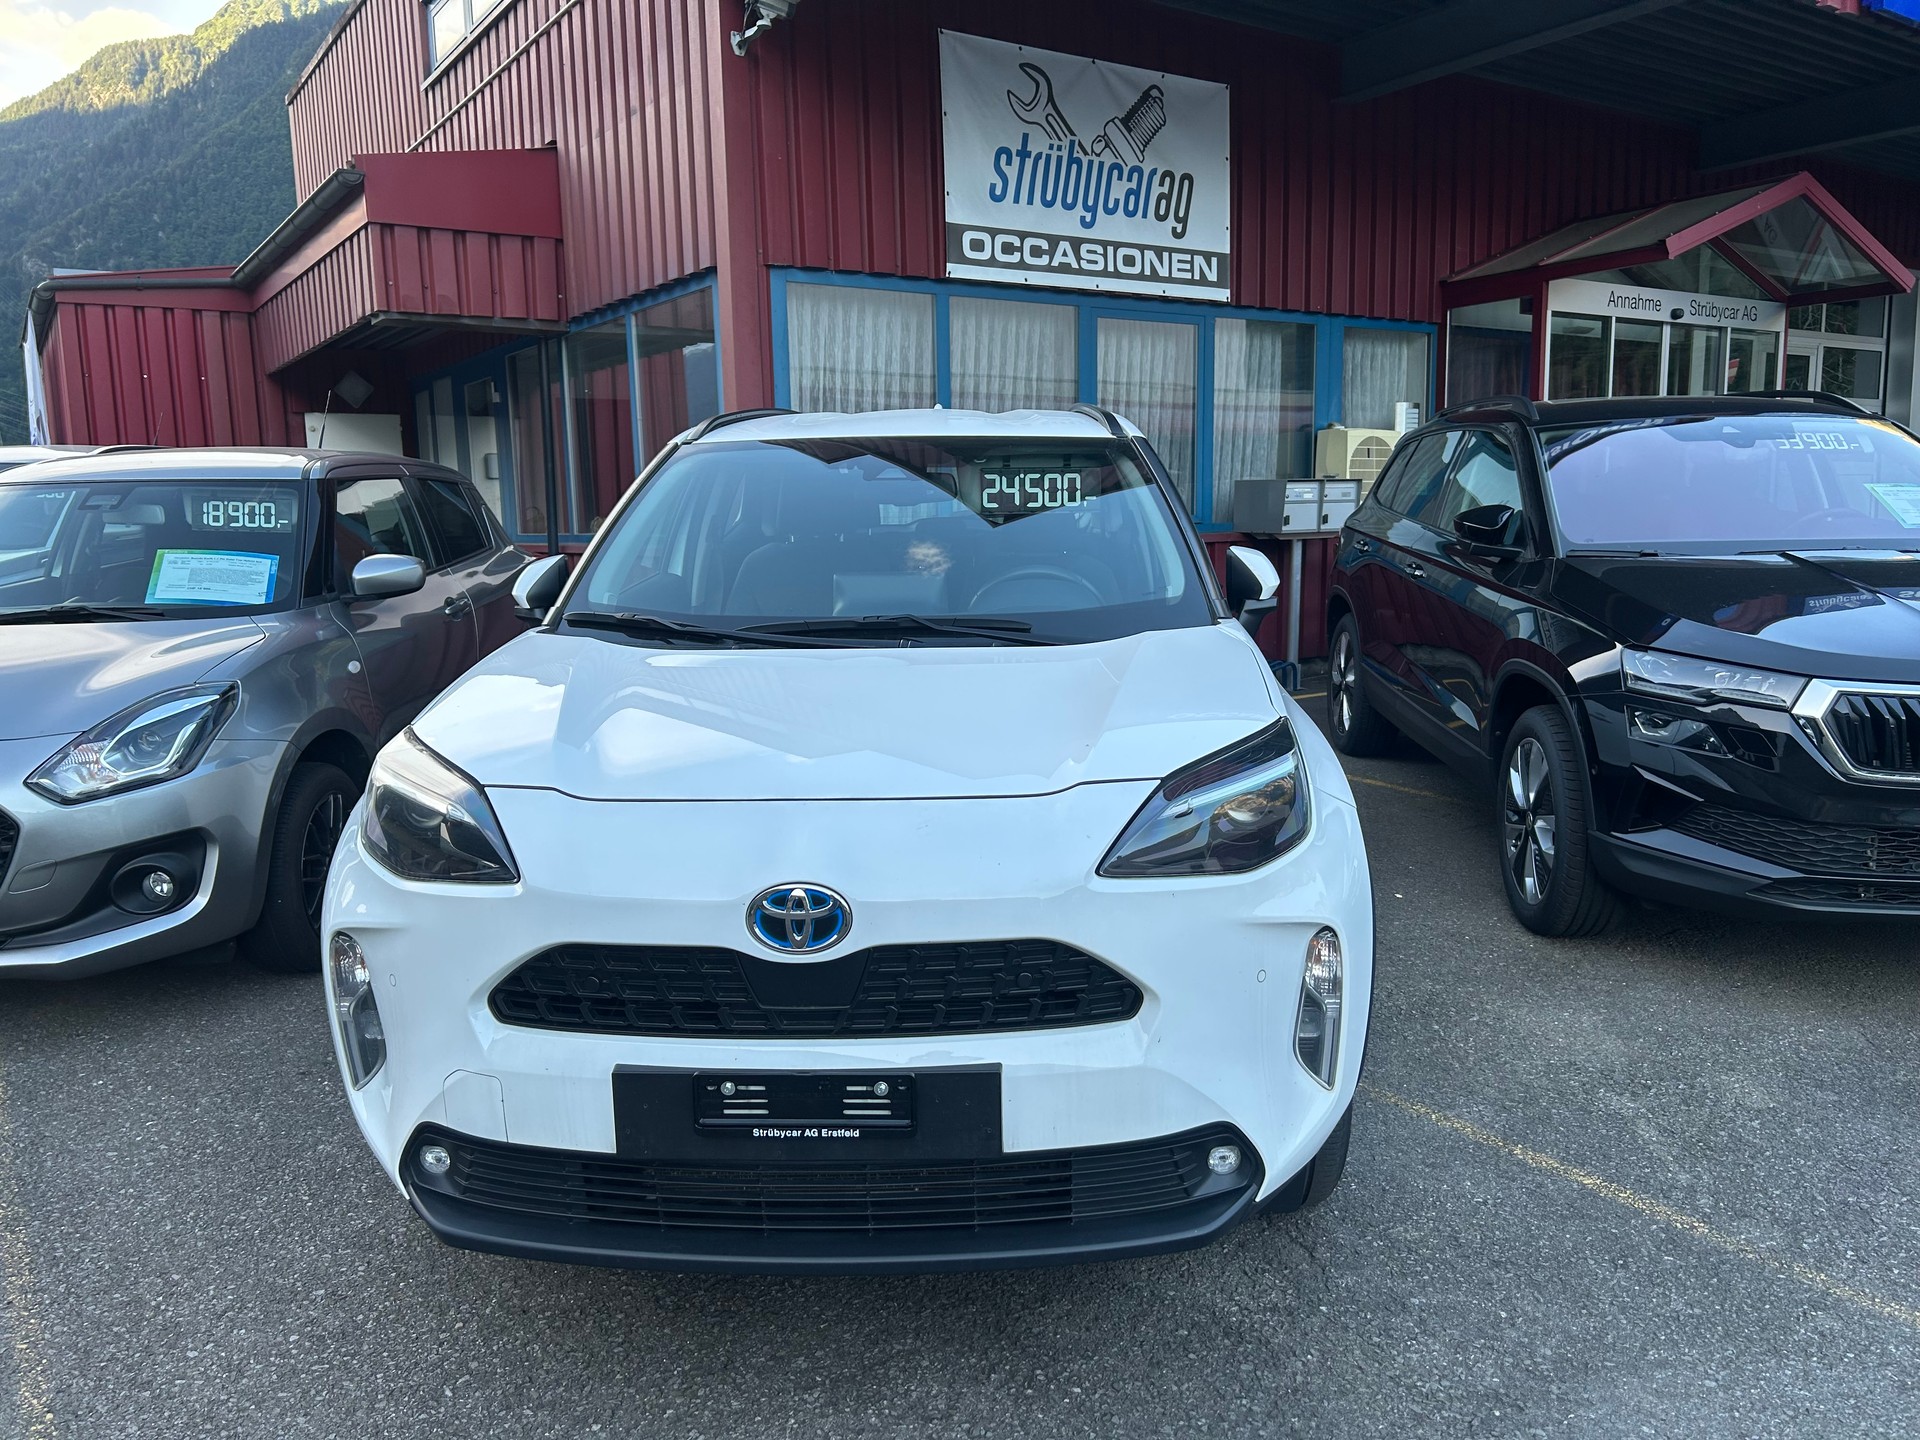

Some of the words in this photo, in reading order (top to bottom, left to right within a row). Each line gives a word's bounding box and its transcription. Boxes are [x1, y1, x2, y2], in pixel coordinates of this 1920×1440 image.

[962, 230, 1218, 282] OCCASIONEN
[1607, 290, 1662, 313] Annahme
[1689, 298, 1740, 323] Strübycar
[1741, 305, 1758, 322] AG
[752, 1128, 802, 1139] Strübycar
[803, 1128, 819, 1138] AG
[821, 1128, 860, 1138] Erstfeld
